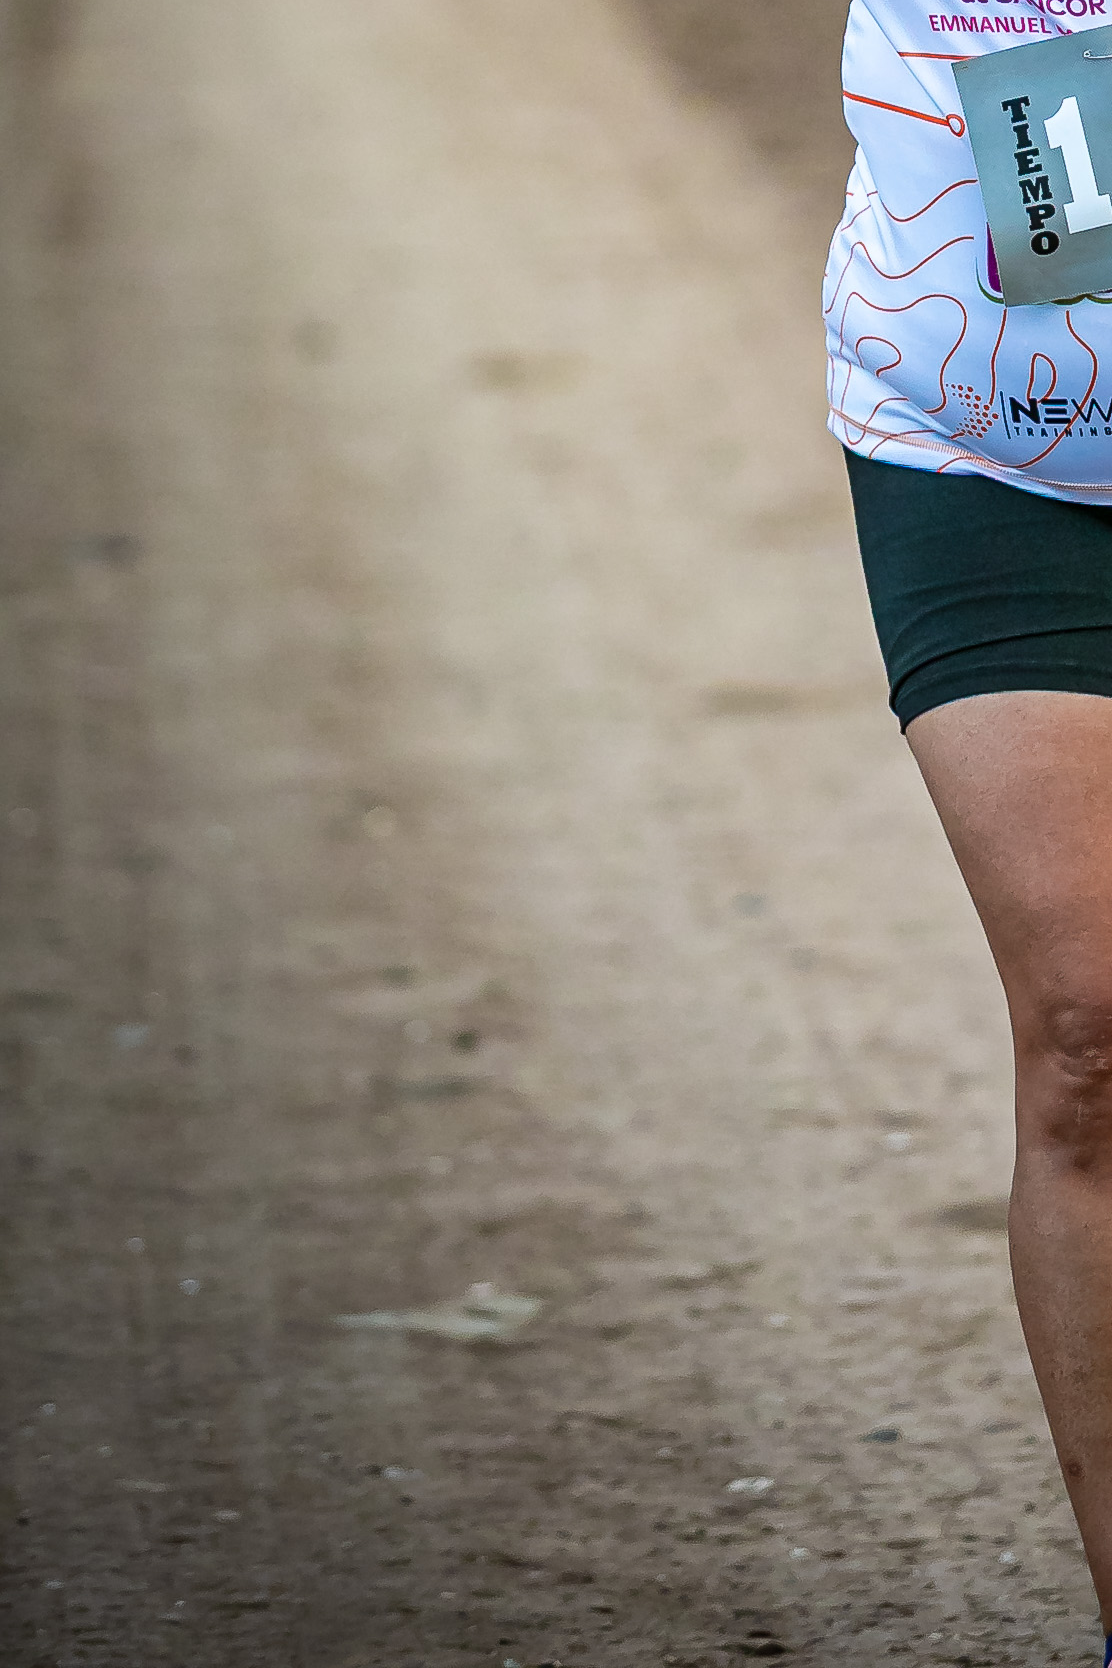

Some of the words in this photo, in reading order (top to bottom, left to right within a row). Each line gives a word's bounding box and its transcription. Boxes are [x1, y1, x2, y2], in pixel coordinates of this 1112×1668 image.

[928, 13, 1053, 34] EMMANUEL
[1001, 95, 1060, 256] TIEMPO
[1013, 426, 1112, 438] TRAINING
